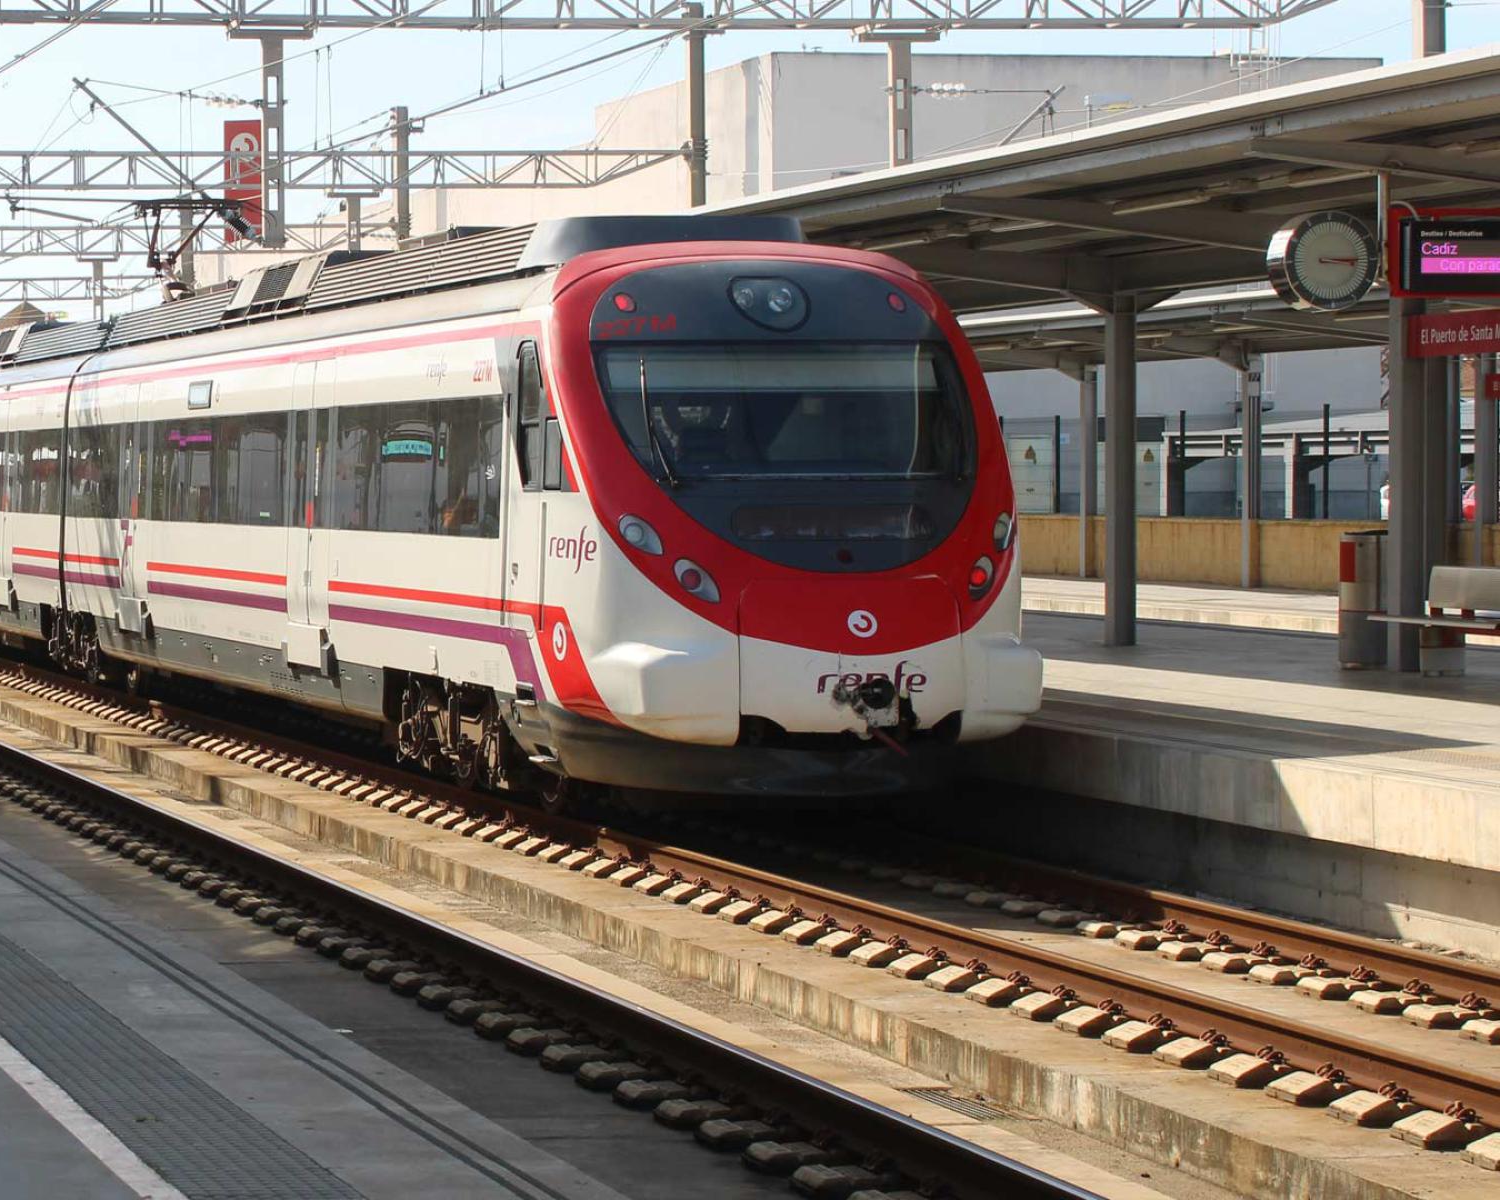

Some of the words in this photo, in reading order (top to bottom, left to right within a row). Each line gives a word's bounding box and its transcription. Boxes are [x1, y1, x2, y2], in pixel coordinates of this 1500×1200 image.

[1440, 259, 1465, 272] Con
[1421, 328, 1429, 344] El
[1430, 328, 1457, 344] Puerto
[1459, 325, 1469, 342] de
[1471, 325, 1493, 341] Santa
[426, 354, 448, 386] renfe
[549, 525, 597, 574] renfe
